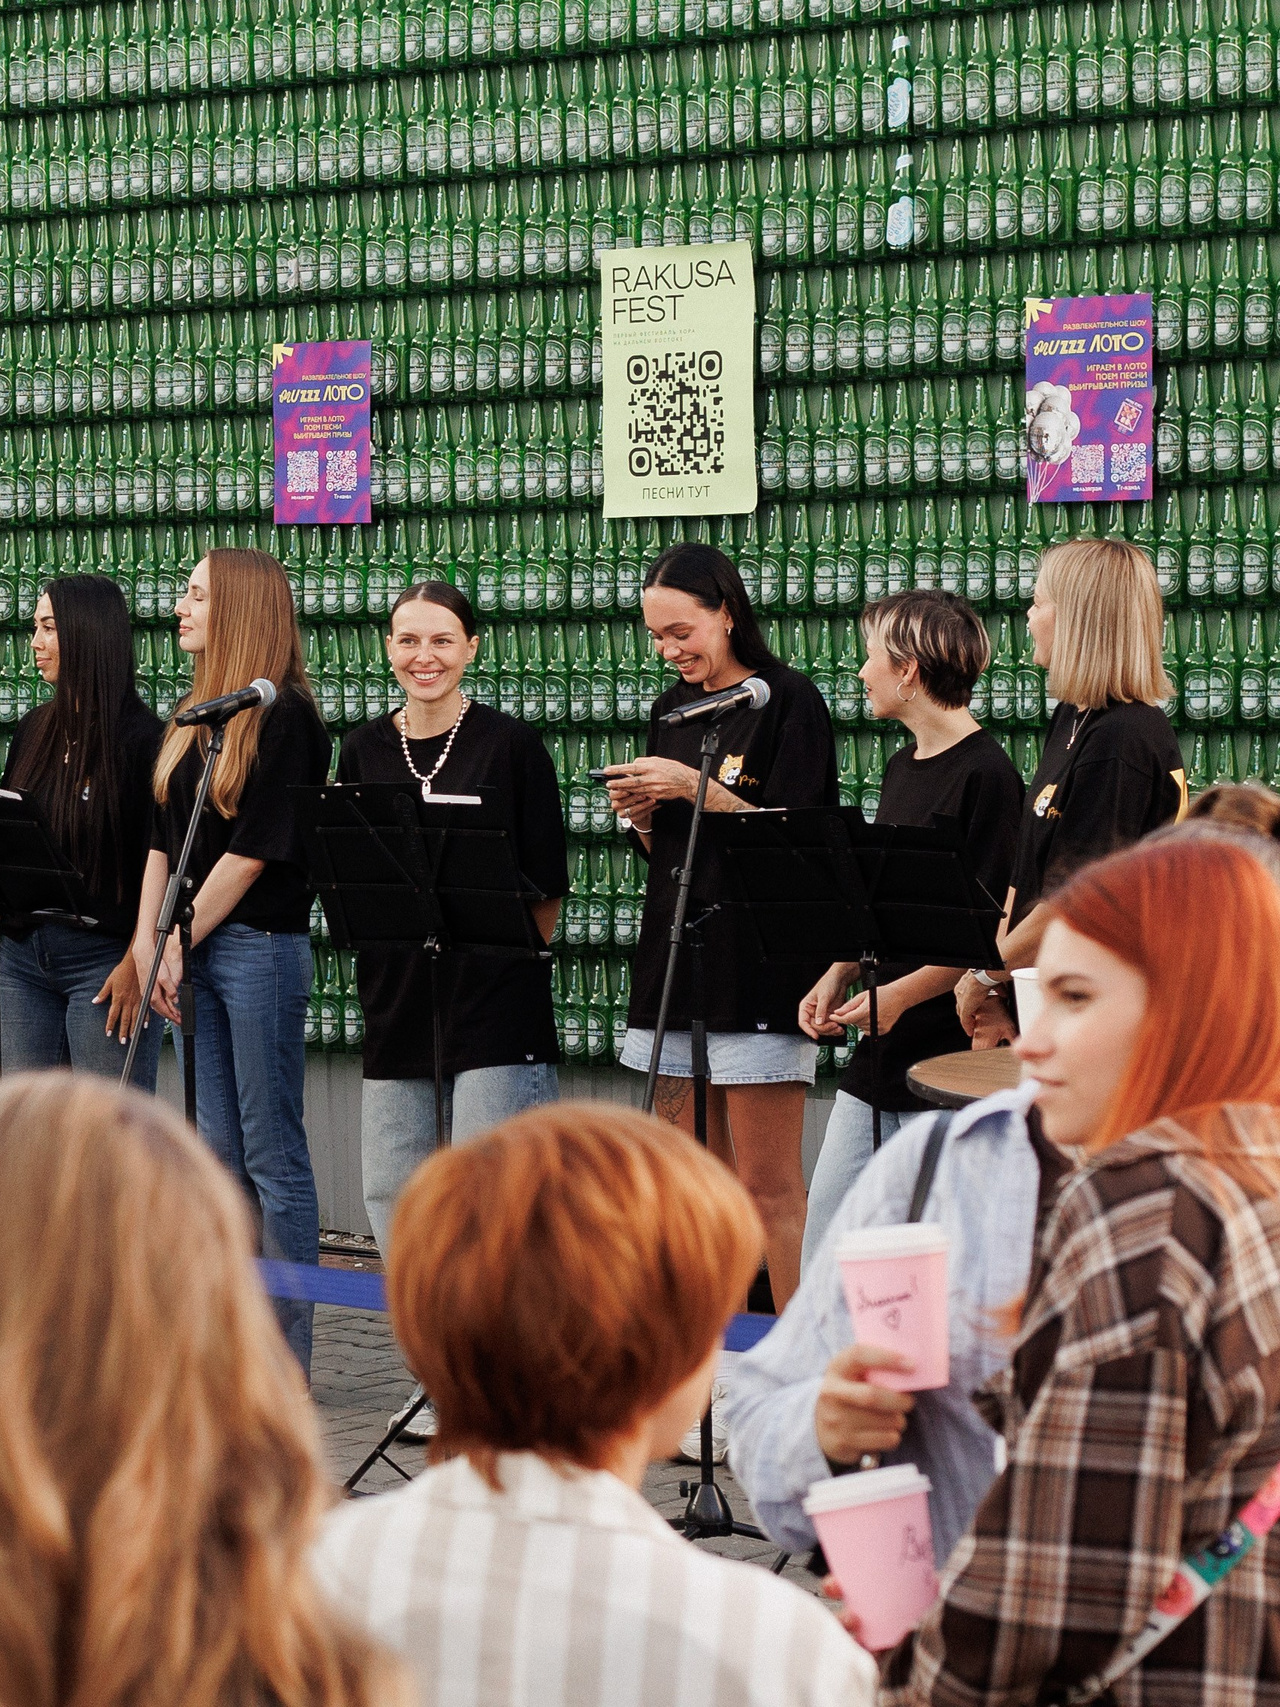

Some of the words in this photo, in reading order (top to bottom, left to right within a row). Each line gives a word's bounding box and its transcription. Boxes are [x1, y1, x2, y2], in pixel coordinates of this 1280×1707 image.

[612, 259, 736, 294] RAKUSA
[612, 294, 685, 325] FEST
[1062, 320, 1128, 331] РАЗВЛЕКАТЕЛЬНОЕ
[1129, 319, 1147, 327] ШОУ
[1088, 331, 1145, 354] ЛОТО
[1086, 363, 1116, 372] ИГРАЕМ
[1117, 363, 1123, 371] В
[1123, 362, 1148, 371] ЛОТО
[1095, 373, 1118, 381] ПОЕМ
[1119, 371, 1148, 380] ПЕСНИ
[322, 383, 365, 402] ЛОТО
[1068, 382, 1119, 392] ВЫИГРЫВАЕМ
[1120, 381, 1148, 389] ПРИЗЫ
[300, 416, 322, 424] ИГРАЕМ
[327, 415, 346, 423] ЛОТО
[321, 423, 342, 431] ПЕСНИ
[642, 487, 684, 500] ПЕСНИ
[687, 485, 711, 499] ТУТ
